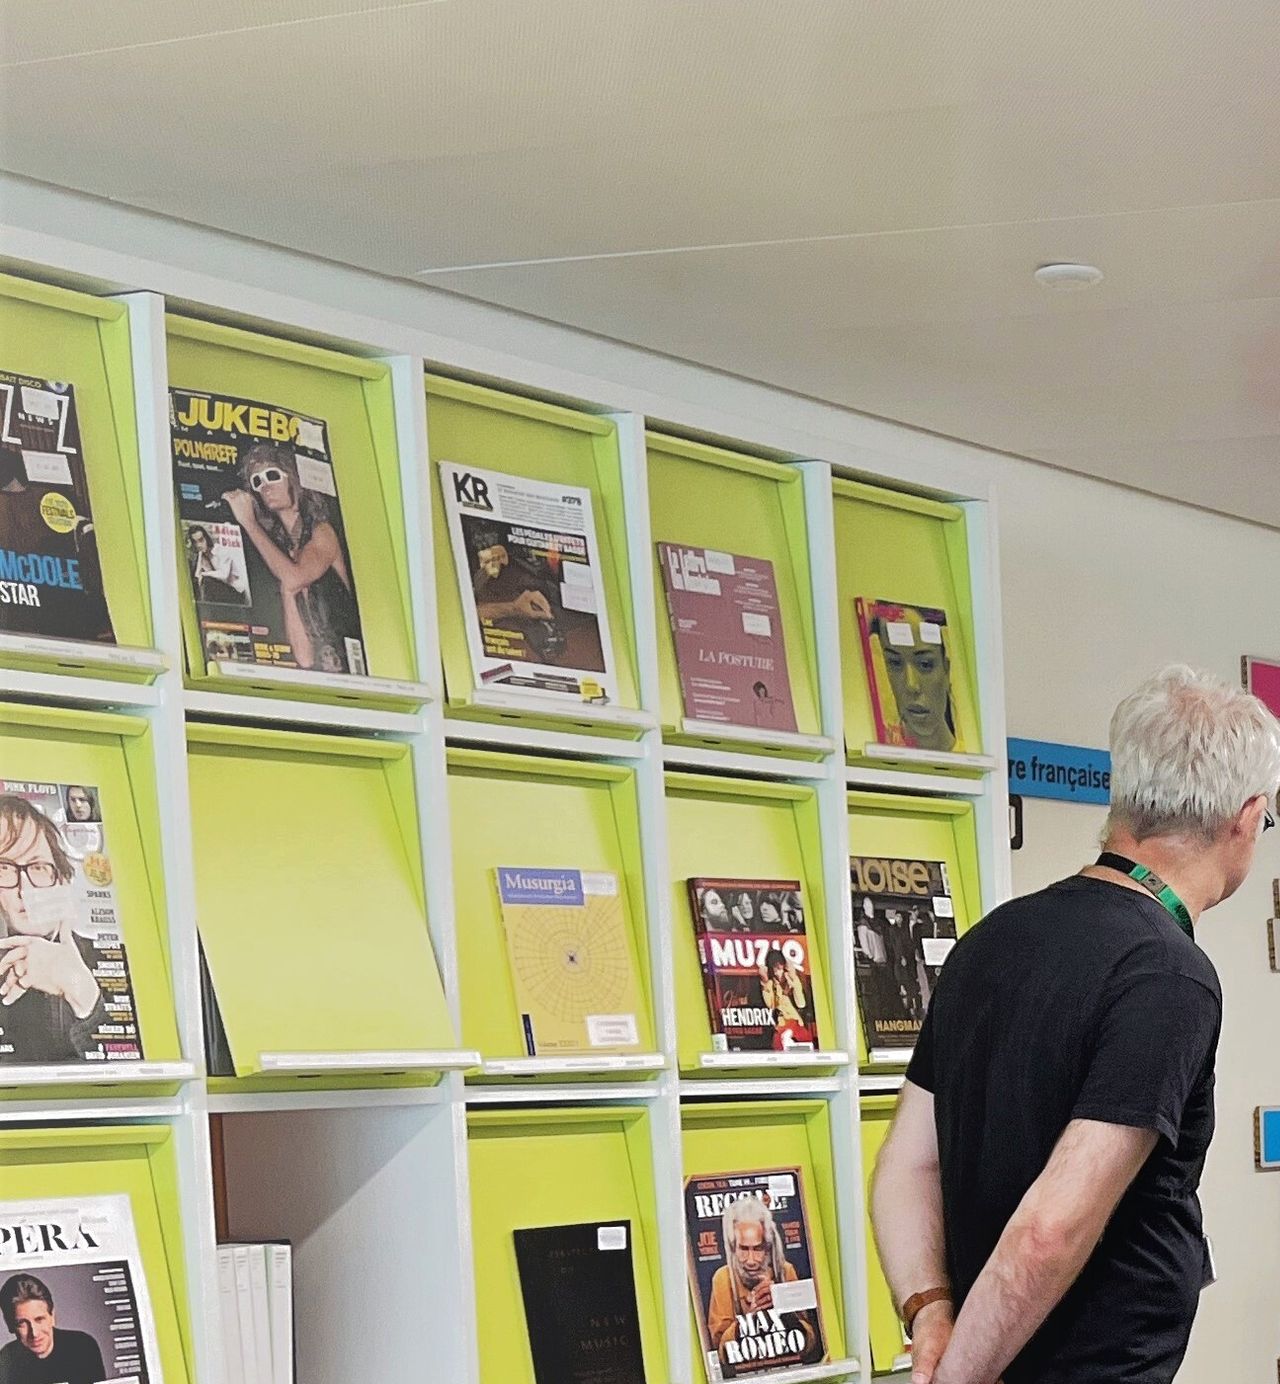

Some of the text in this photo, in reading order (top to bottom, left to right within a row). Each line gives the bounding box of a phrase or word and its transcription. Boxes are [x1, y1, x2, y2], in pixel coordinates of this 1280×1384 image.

[452, 472, 494, 511] KR
[699, 649, 775, 672] LA POSTURE
[1031, 756, 1111, 792] française
[504, 872, 576, 895] Musurgia
[720, 1007, 776, 1027] HENDRIX
[736, 1309, 787, 1338] MAX
[725, 1328, 806, 1364] ROMEO
